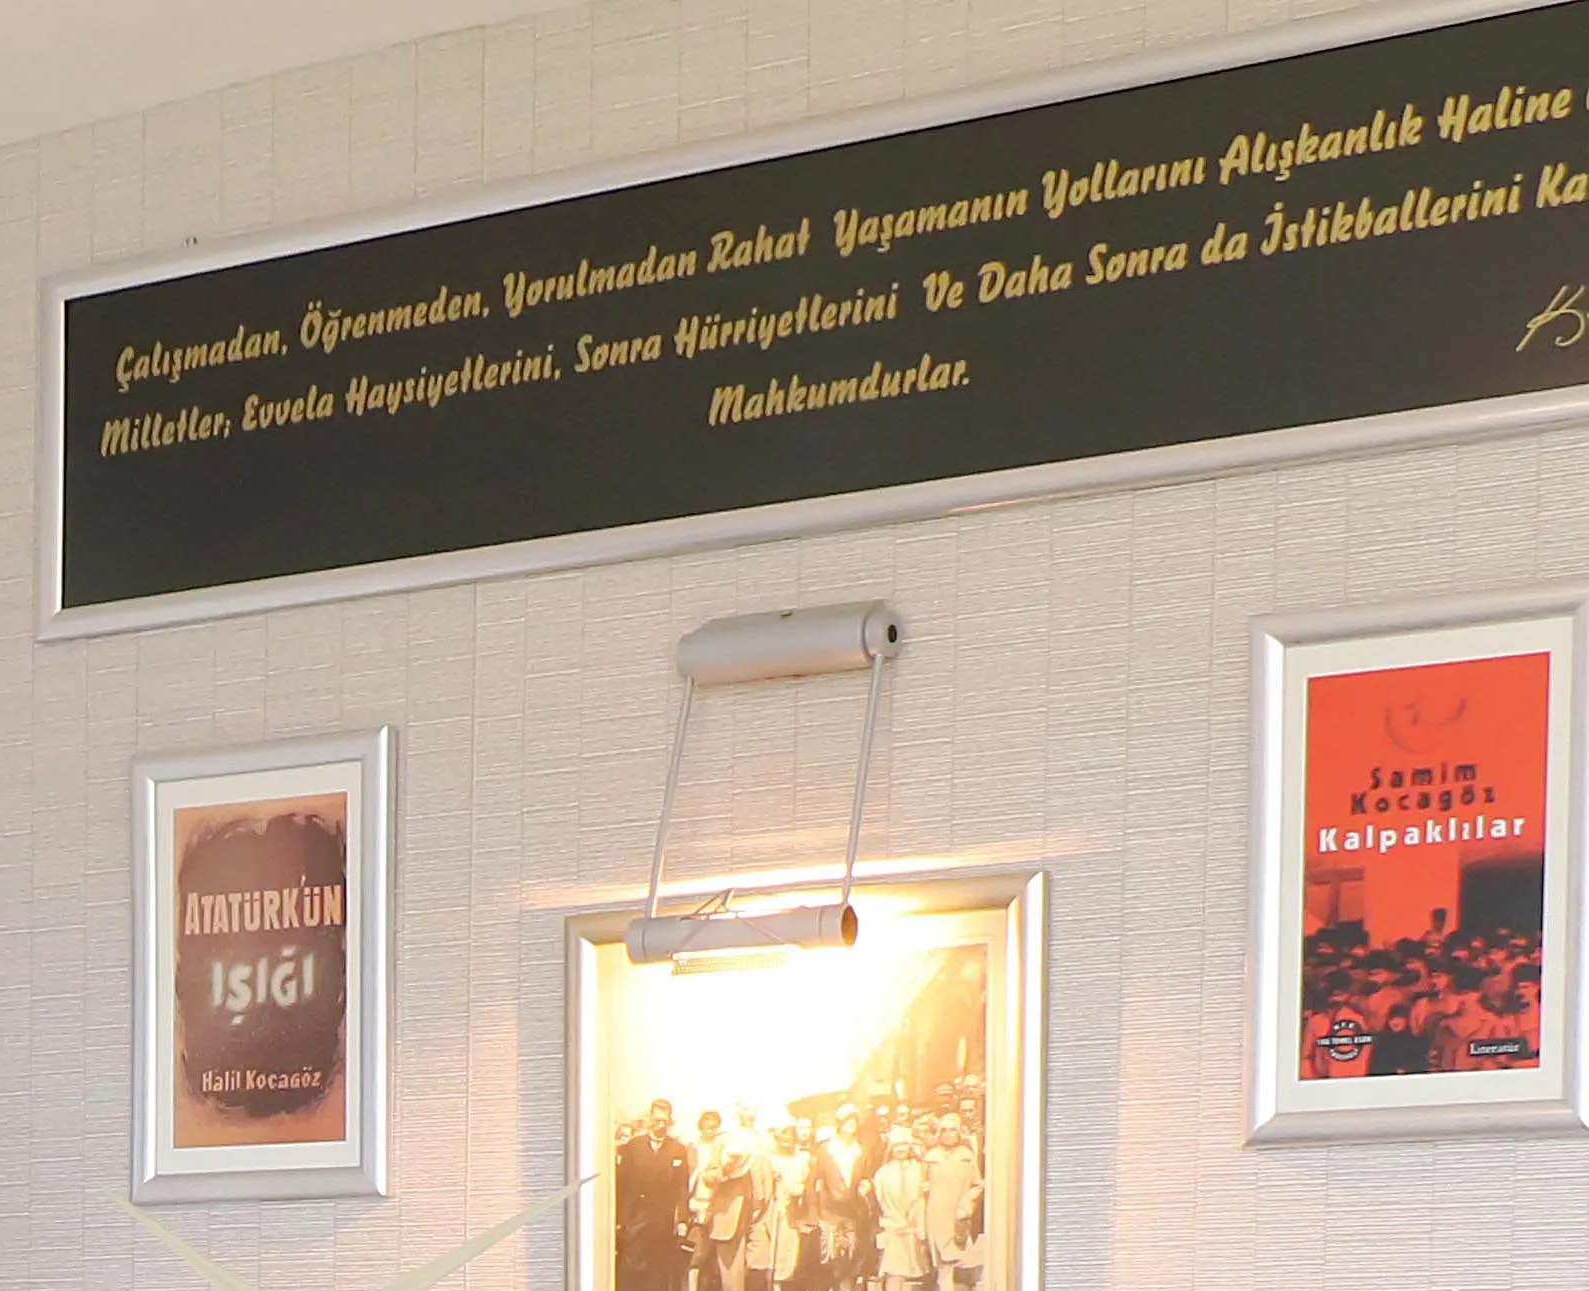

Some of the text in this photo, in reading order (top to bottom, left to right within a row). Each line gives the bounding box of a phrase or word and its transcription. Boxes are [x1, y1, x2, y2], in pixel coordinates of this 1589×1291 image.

[115, 84, 1575, 393] Çalışmadan, Öğrenmeden, Yorulmadan Rahat Yaşamanın Yollarını Alışkanlık Haline
[240, 383, 335, 431] Evvela
[344, 350, 562, 416] Haysiyetlerini,
[574, 333, 663, 373] Sonra
[674, 281, 898, 360] Hürriyetlerini
[923, 270, 966, 312] Ve
[977, 254, 1075, 304] Daha
[1083, 241, 1190, 286] Sonra
[1199, 221, 1250, 267] da
[1258, 171, 1525, 256] İstikballerini
[707, 353, 971, 425] Mahkumdurlar.
[1350, 785, 1495, 815] Kocagöz
[1370, 762, 1477, 790] Samim
[1318, 815, 1526, 853] Kalpaklılar
[184, 874, 342, 935] ATATÜRK'ÜN
[211, 945, 314, 1027] IŞIĞI
[202, 1070, 241, 1093] Halil
